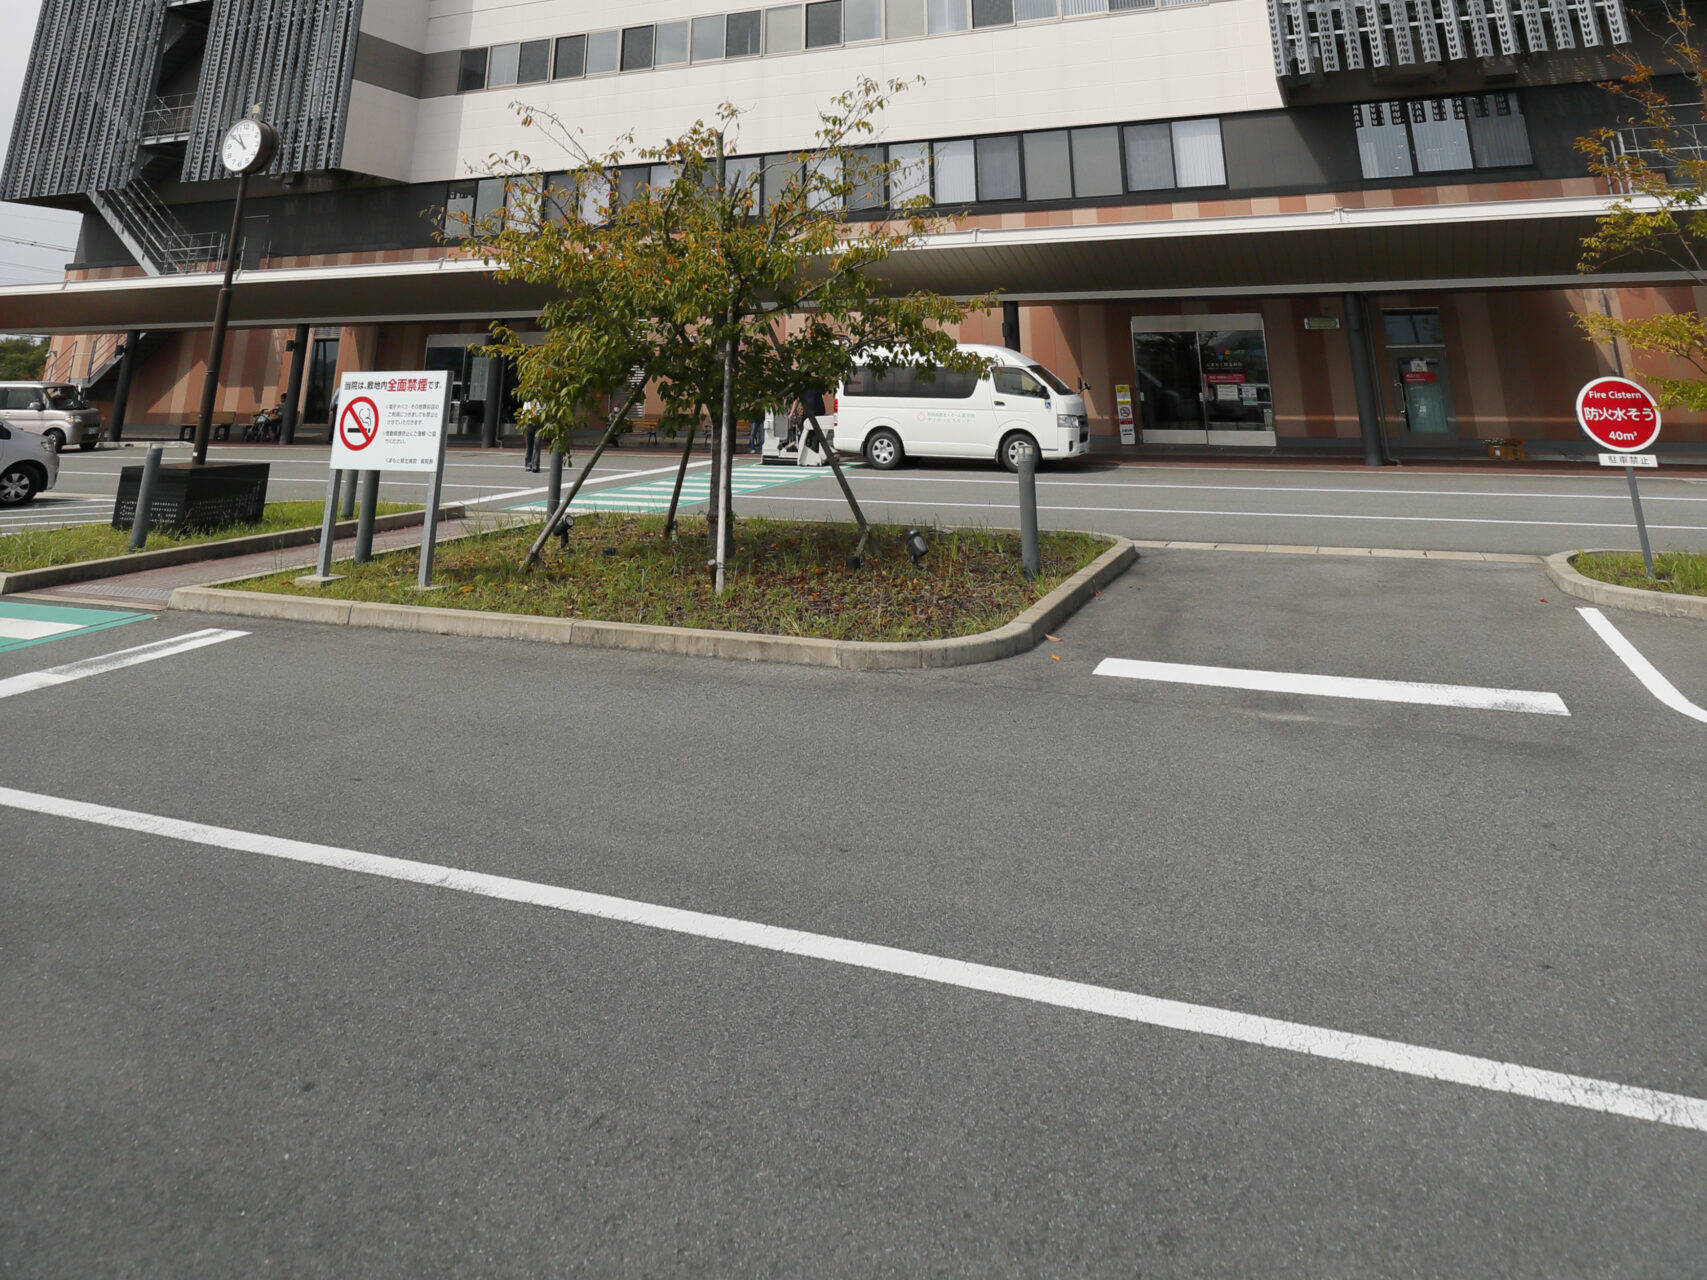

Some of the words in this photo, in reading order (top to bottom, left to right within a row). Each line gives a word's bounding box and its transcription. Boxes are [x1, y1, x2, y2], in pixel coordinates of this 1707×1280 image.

[344, 378, 442, 392] 当院は、敷地内全面禁煙です。
[1588, 391, 1607, 399] Fire
[1608, 391, 1642, 399] Cistern
[1583, 407, 1654, 422] 防火水そう
[1608, 455, 1649, 465] 駐車禁止
